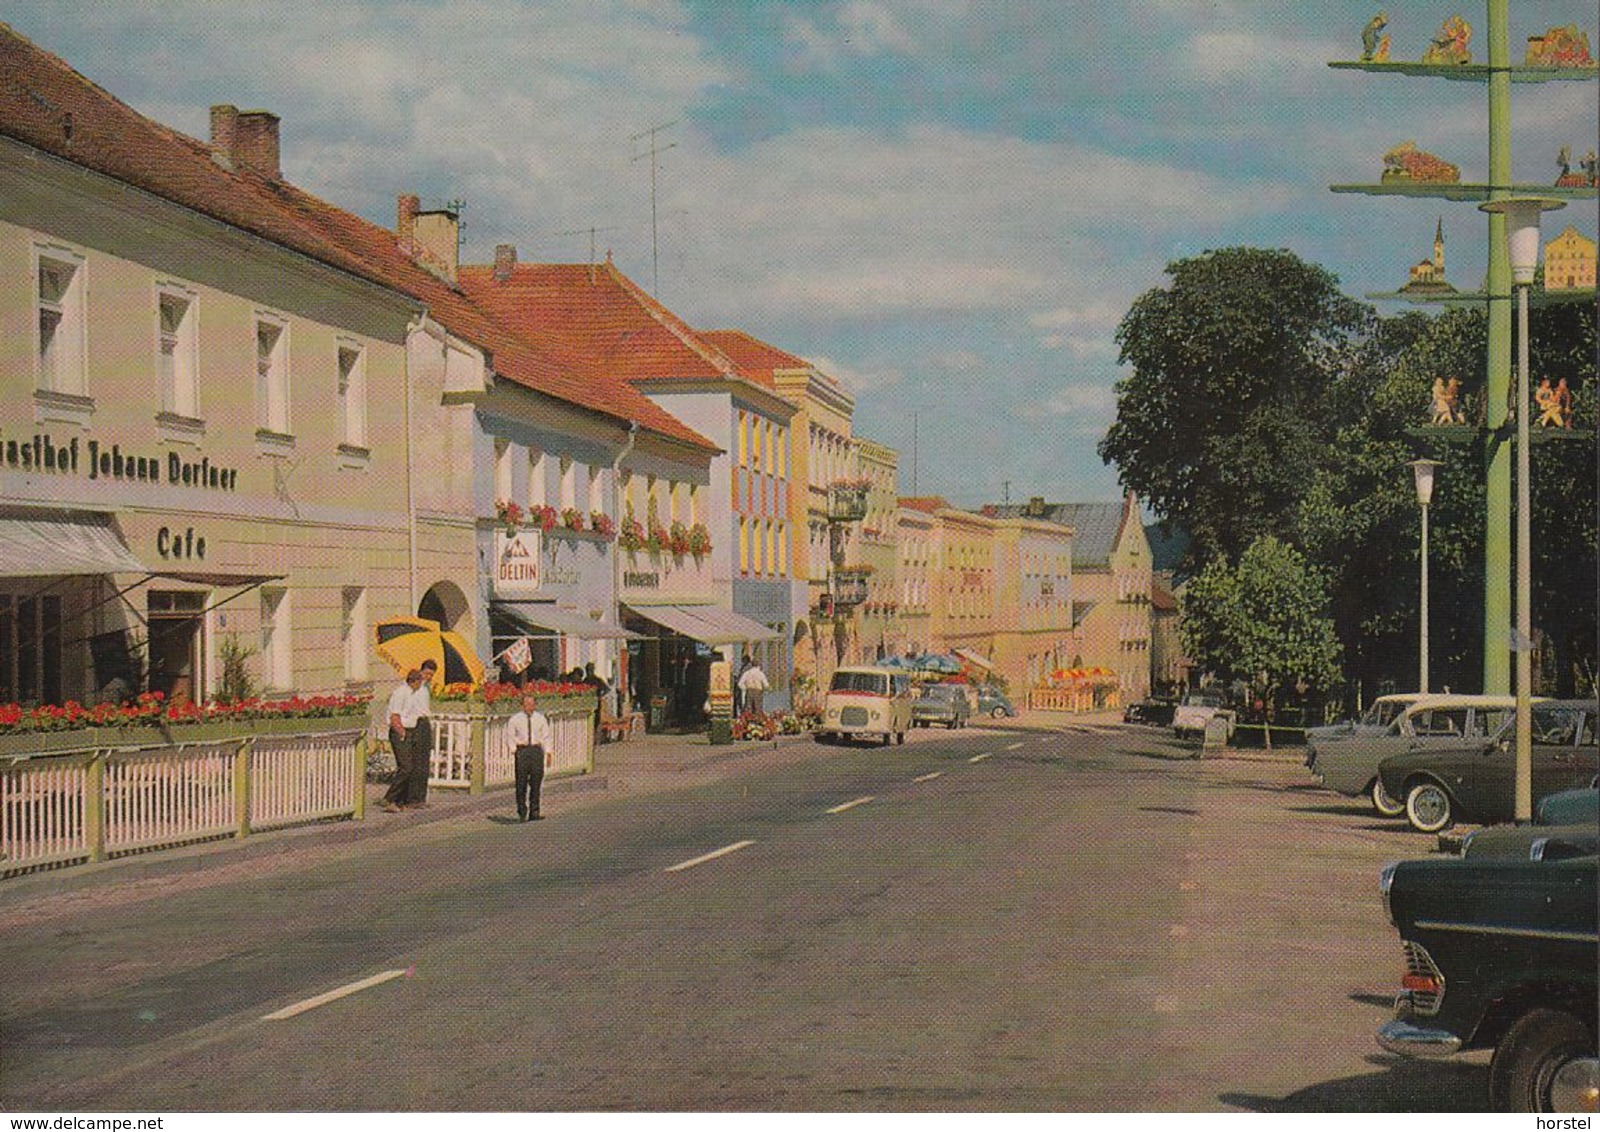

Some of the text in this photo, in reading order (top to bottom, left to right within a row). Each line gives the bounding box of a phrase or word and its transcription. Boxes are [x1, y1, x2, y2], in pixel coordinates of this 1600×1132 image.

[88, 441, 159, 480] Johann
[168, 451, 238, 490] Dorfner
[157, 527, 206, 558] Cafe
[500, 563, 537, 580] DELTIN
